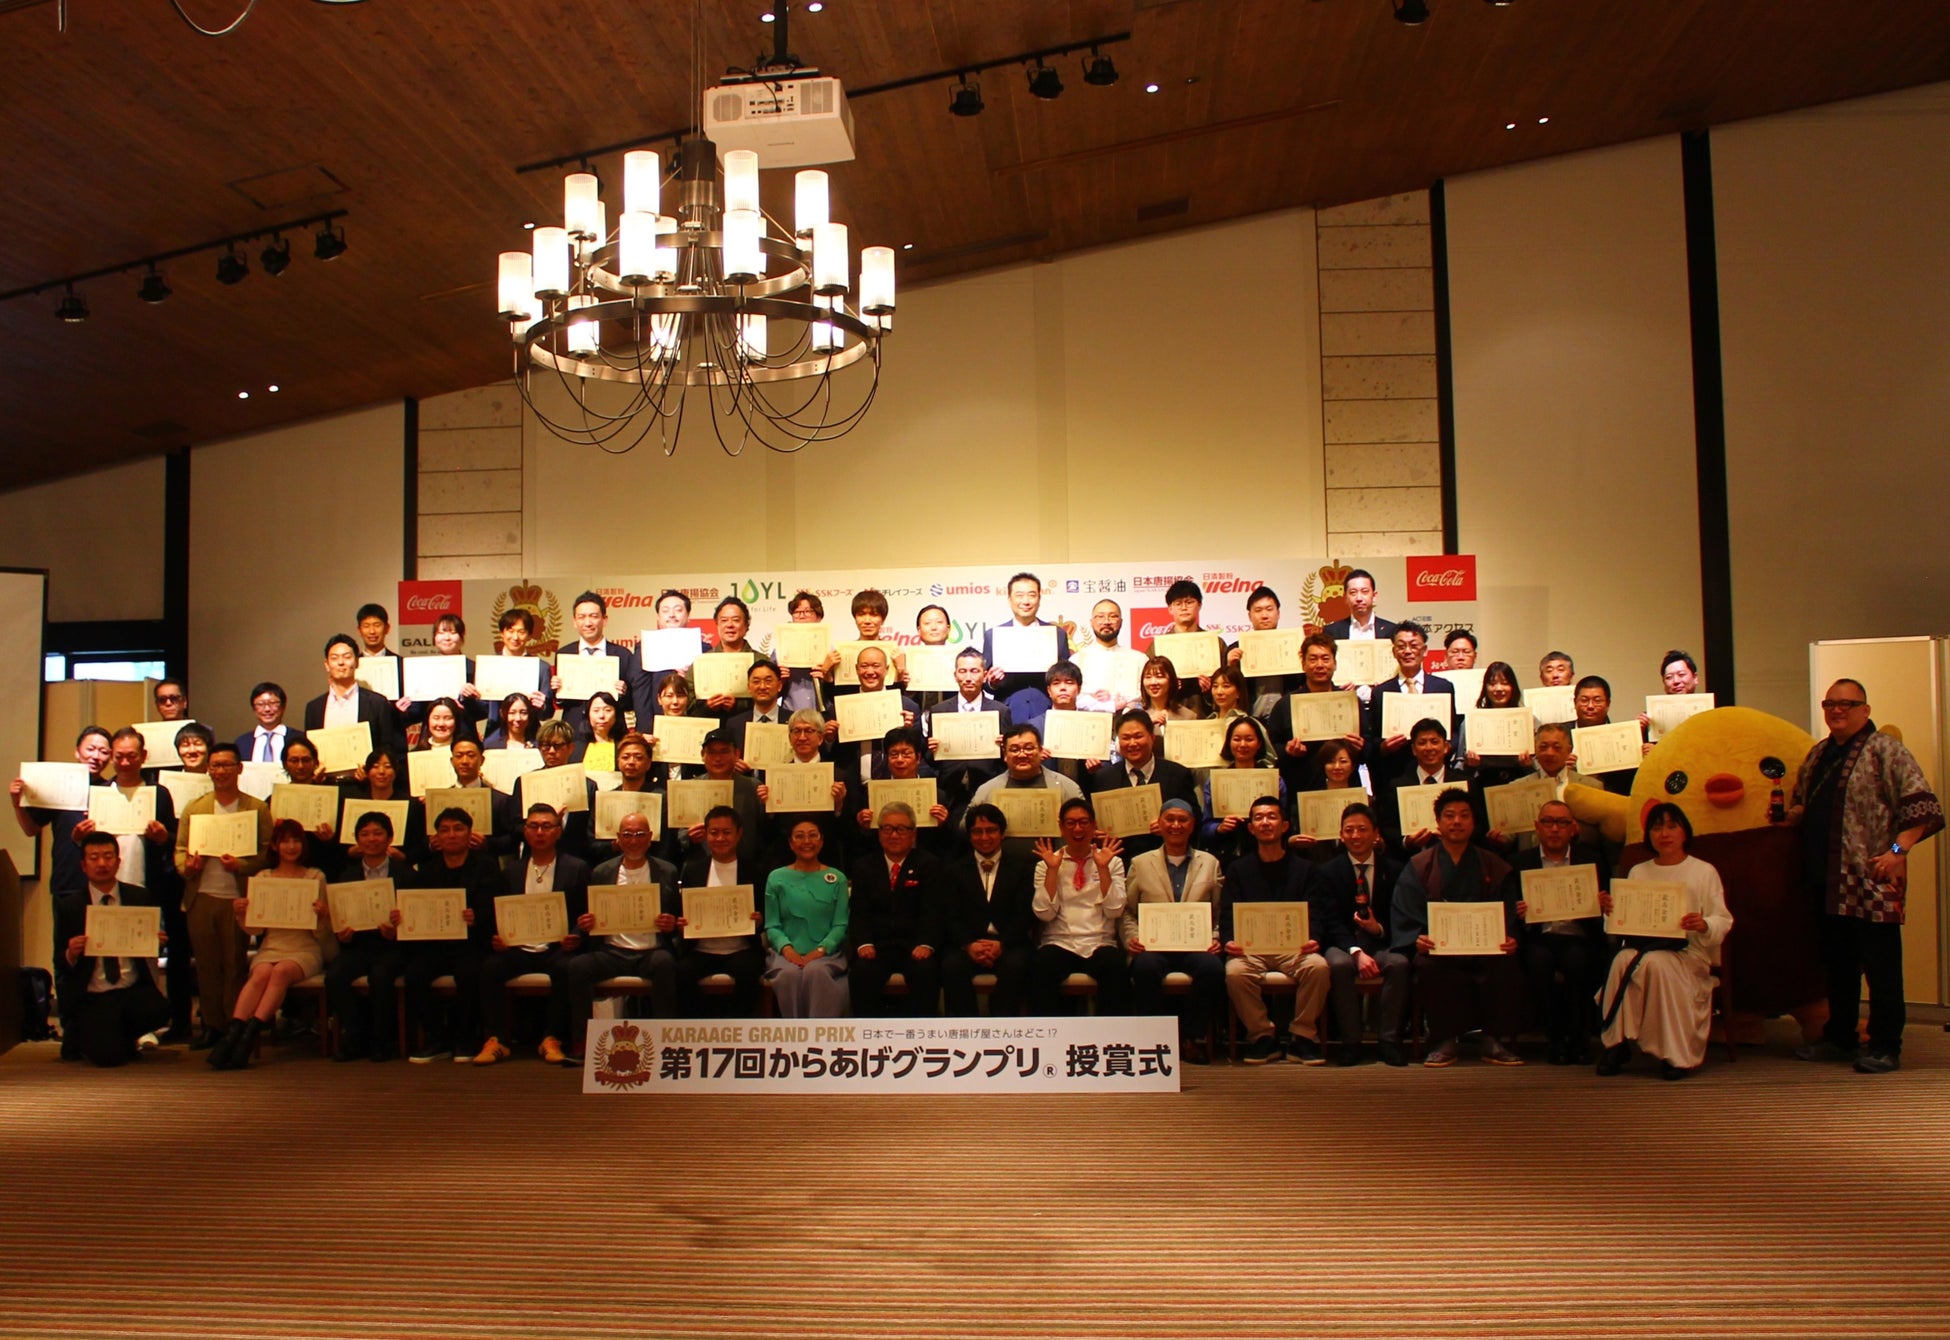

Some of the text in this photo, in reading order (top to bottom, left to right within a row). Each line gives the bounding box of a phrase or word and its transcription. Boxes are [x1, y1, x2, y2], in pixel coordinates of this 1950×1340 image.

[1416, 569, 1466, 587] Coca-Cola
[946, 582, 991, 595] umios
[1423, 623, 1474, 633] 本アクセス
[661, 1026, 855, 1043] KARAAGE GRAND PRIX
[1066, 1044, 1173, 1077] 授賞式
